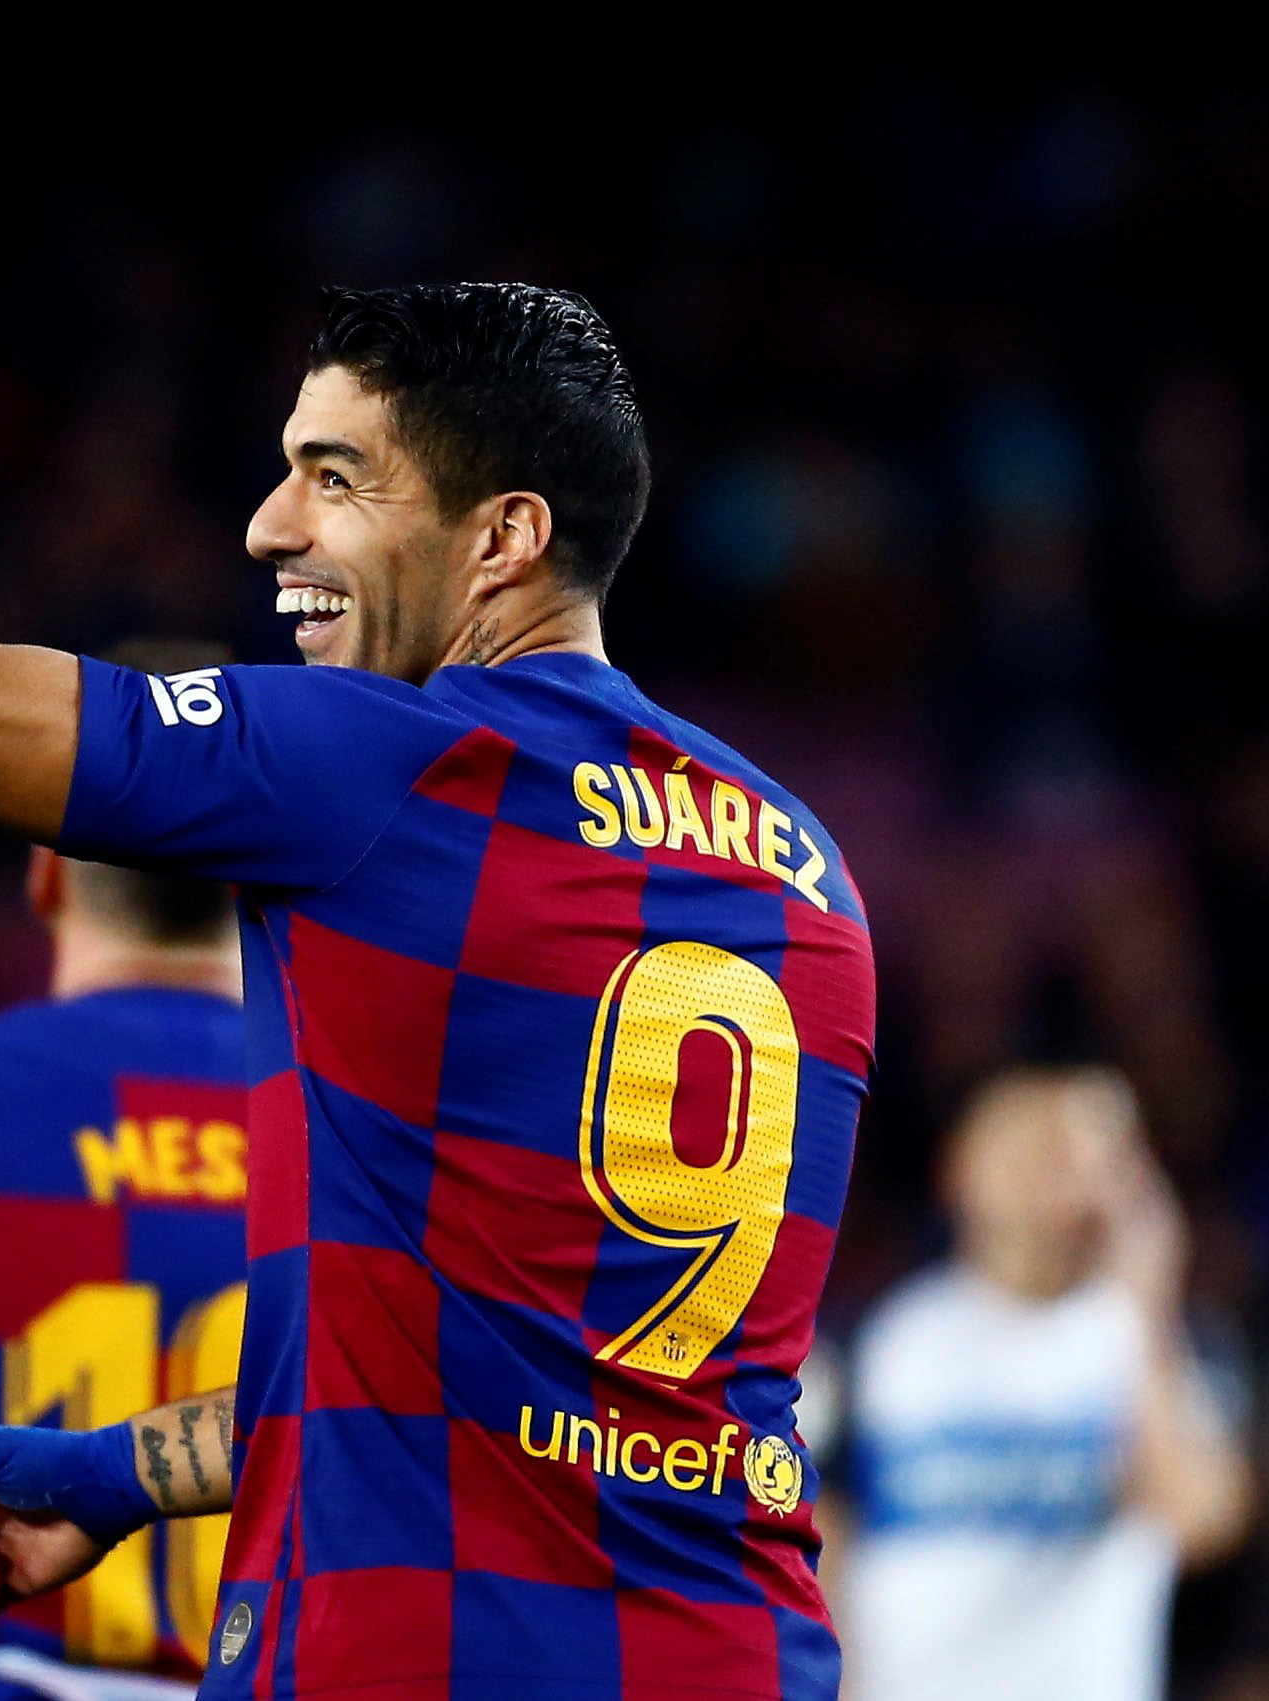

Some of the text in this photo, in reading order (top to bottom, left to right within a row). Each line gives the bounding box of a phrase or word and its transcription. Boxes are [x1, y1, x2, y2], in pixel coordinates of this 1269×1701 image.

[572, 755, 829, 914] SUÁREZ
[75, 1116, 248, 1206] MES
[578, 940, 800, 1380] 9
[518, 1405, 740, 1496] unicef
